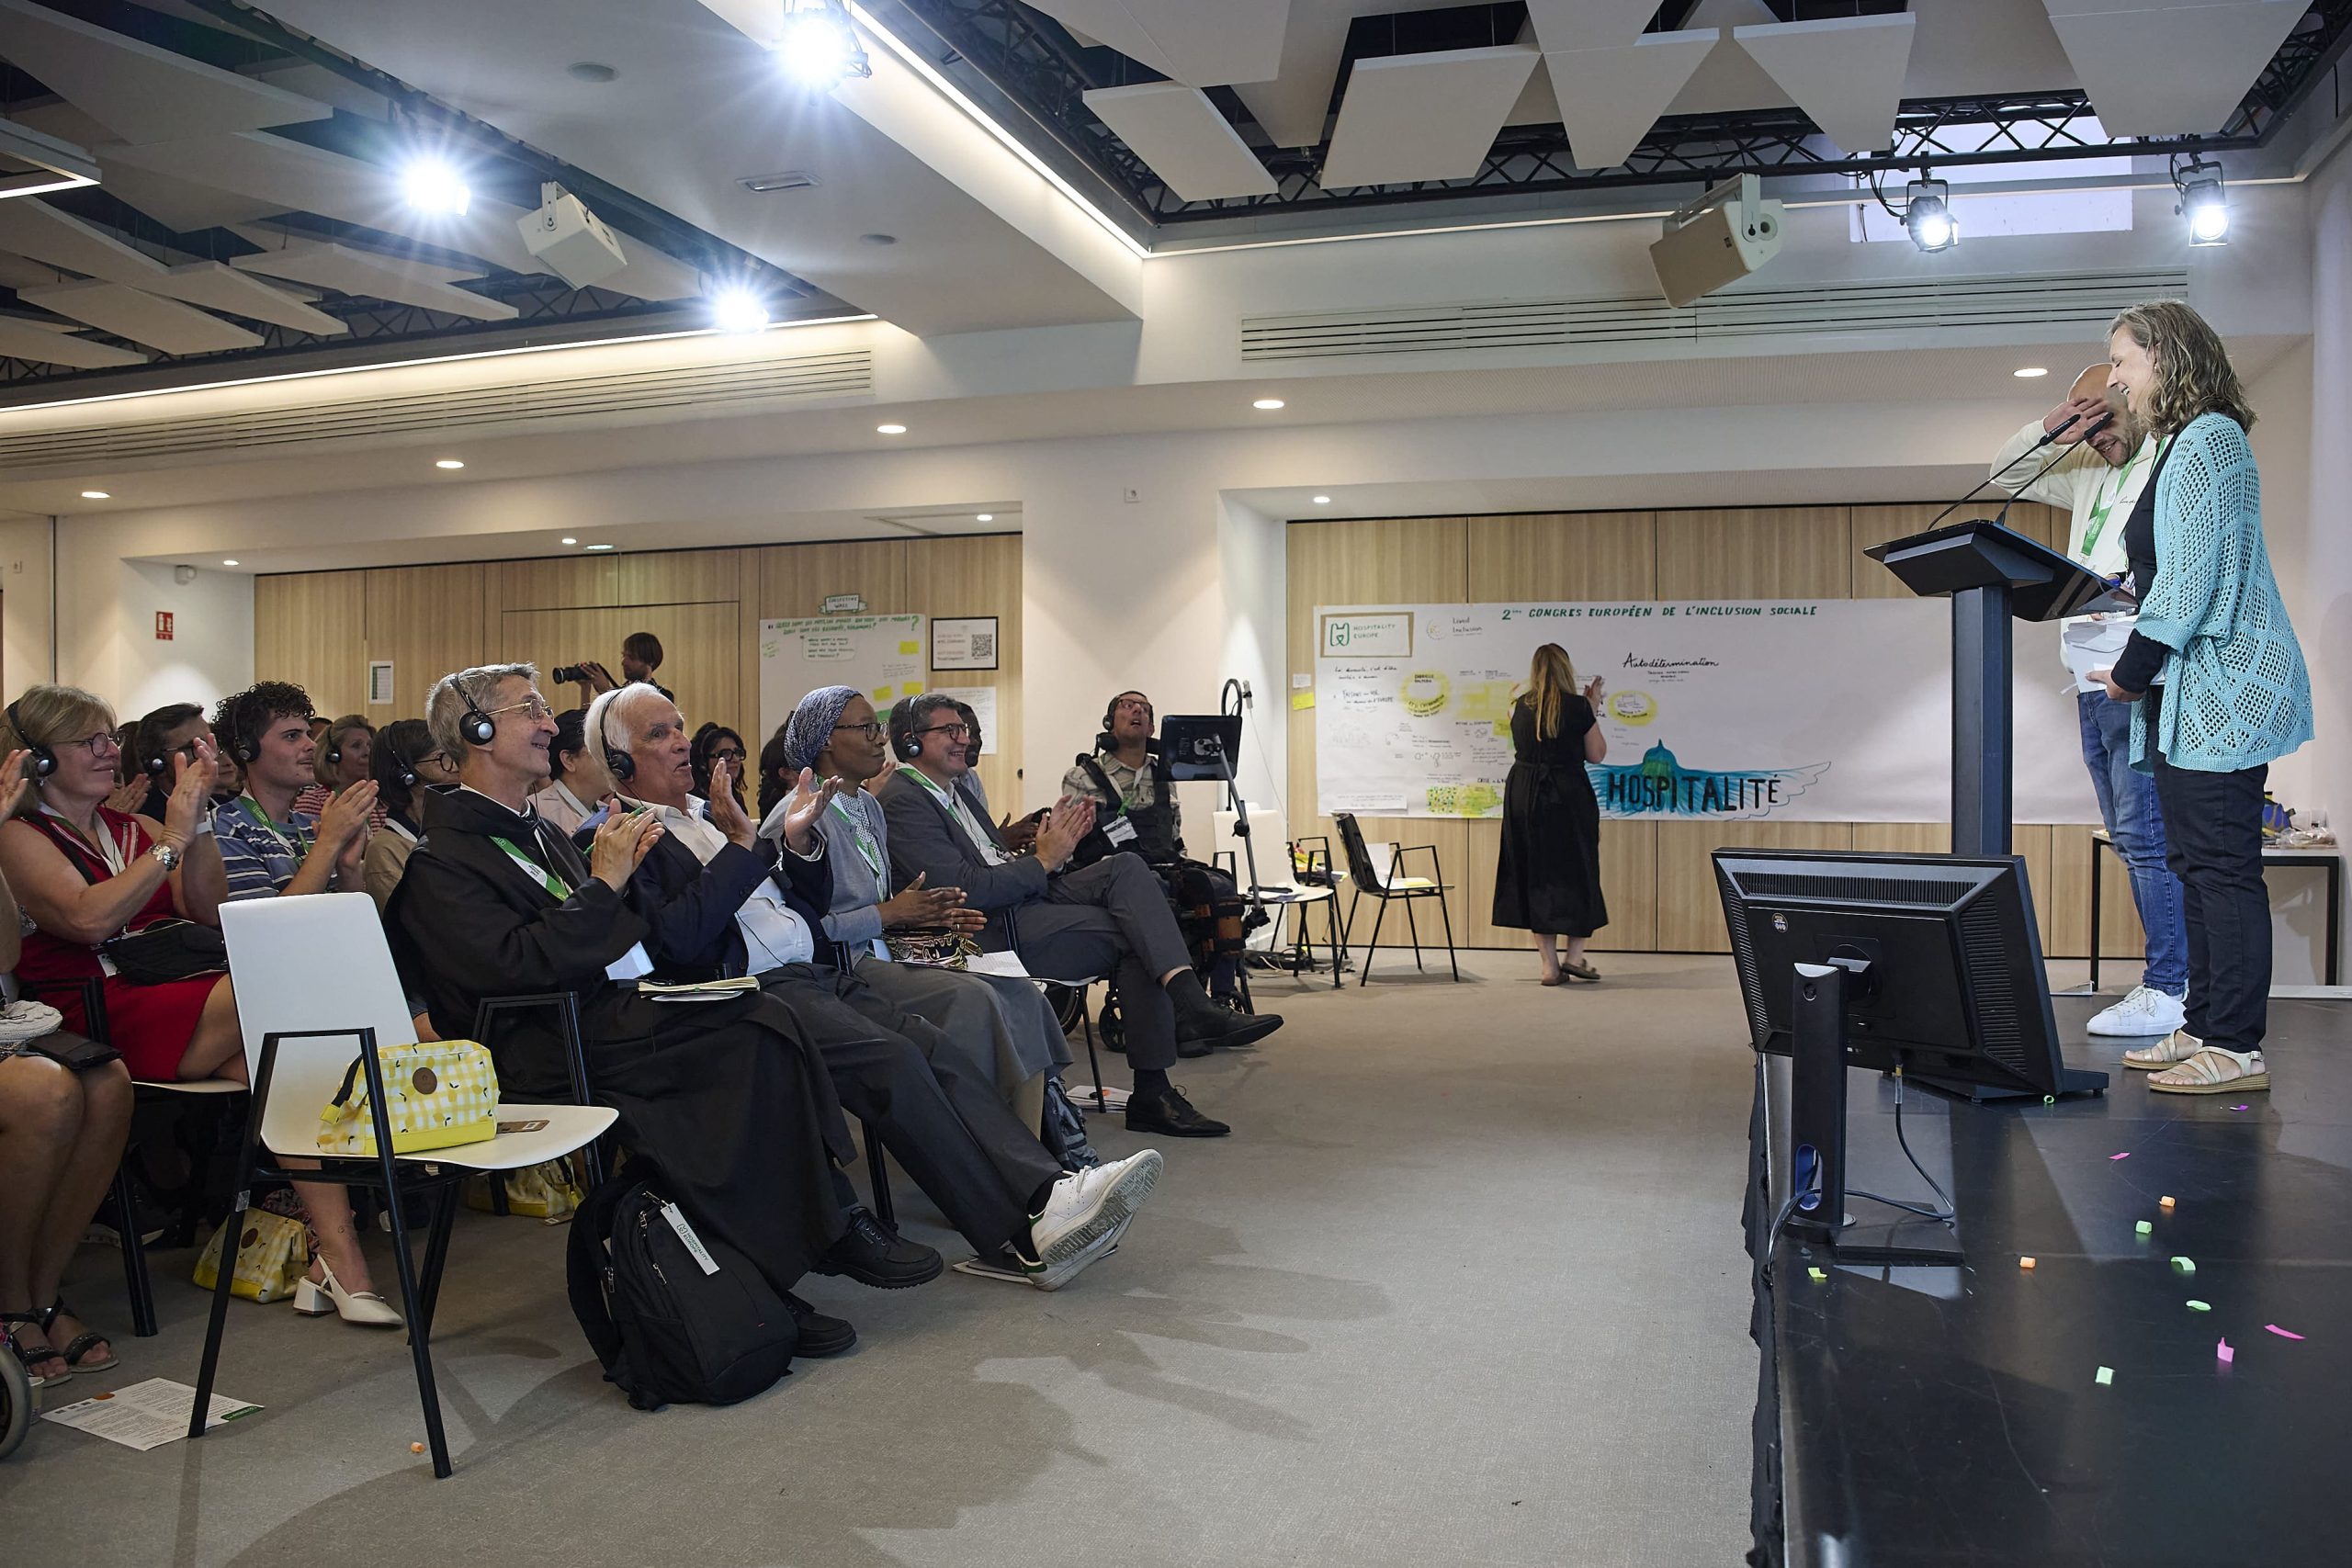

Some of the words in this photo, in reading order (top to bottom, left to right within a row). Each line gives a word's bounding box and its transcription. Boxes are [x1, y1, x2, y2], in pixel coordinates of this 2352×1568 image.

[1589, 604, 1653, 618] EUROPÉEN
[1662, 607, 1677, 616] DE
[1686, 606, 1762, 616] L'INCLUSION
[1770, 606, 1817, 616] SOCIALE
[1623, 651, 1719, 669] Autodétermination
[1609, 773, 1781, 812] HOSPITALITÉ
[683, 1234, 698, 1253] EUROPE
[686, 1232, 709, 1261] HOSPITALITY
